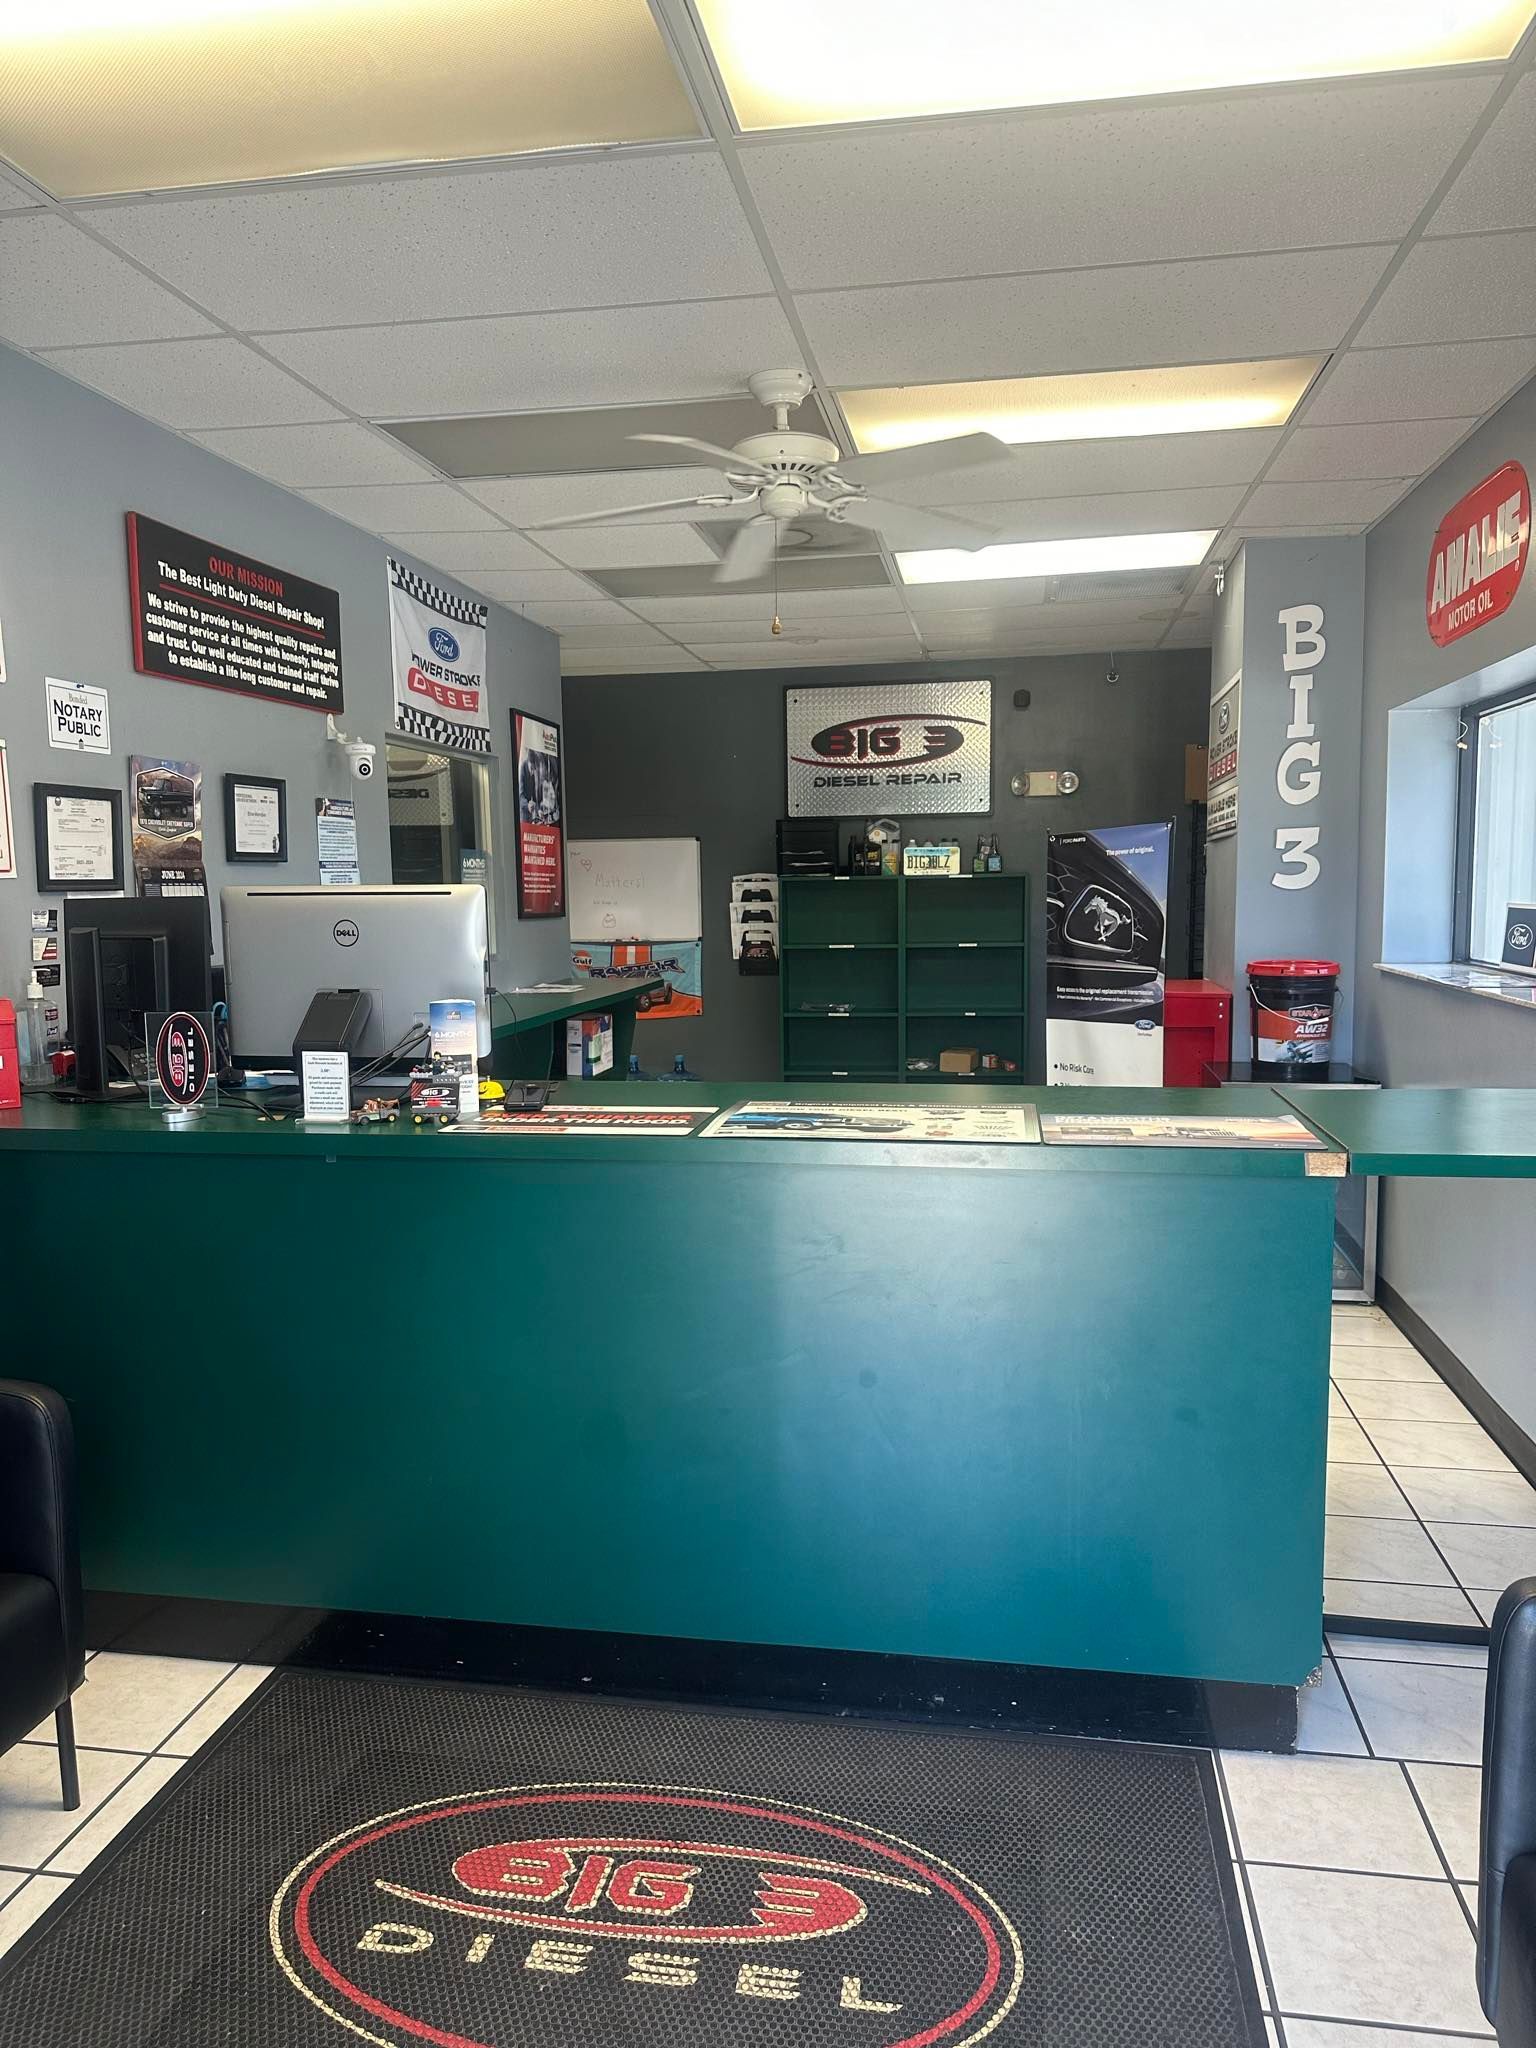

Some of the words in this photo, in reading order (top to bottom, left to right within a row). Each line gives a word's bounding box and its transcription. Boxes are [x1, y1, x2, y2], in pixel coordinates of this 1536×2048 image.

[1431, 490, 1521, 614] AMALIE
[158, 561, 177, 580] The
[180, 569, 201, 588] Best
[204, 577, 226, 597] Light
[229, 587, 248, 606] Duty
[250, 593, 275, 612] Diesel
[277, 602, 301, 620] Repair
[304, 611, 324, 629] Shop!
[209, 557, 234, 580] OUR
[238, 569, 283, 597] MISSION
[148, 593, 161, 608] We
[164, 599, 188, 616] strive
[190, 606, 198, 619] to
[201, 611, 230, 628] provide
[232, 619, 244, 633] the
[246, 624, 273, 642] highest
[275, 634, 298, 651] quality
[300, 642, 322, 656] repairs
[324, 649, 335, 659] and
[1448, 599, 1476, 630] MOTOR
[1478, 588, 1493, 613] OIL
[146, 613, 187, 632] customer
[189, 624, 219, 641] service
[221, 634, 229, 644] at
[231, 637, 240, 647] all
[243, 640, 263, 653] times
[265, 645, 280, 658] with
[282, 652, 310, 667] honesty,
[311, 659, 338, 676] integrity
[148, 631, 164, 644] and
[166, 636, 190, 651] trust.
[192, 641, 206, 654] Our
[209, 646, 225, 660] well
[227, 651, 261, 668] educated
[263, 660, 276, 672] and
[278, 664, 301, 680] trained
[304, 673, 319, 685] staff
[321, 676, 339, 688] thrive
[434, 633, 453, 656] Ford
[169, 651, 178, 664] to
[180, 657, 217, 673] establish
[219, 666, 224, 675] a
[226, 665, 238, 678] life
[240, 670, 256, 685] long
[258, 675, 290, 691] customer
[293, 681, 305, 693] and
[306, 687, 327, 699] repair.
[54, 699, 103, 721] NOTARY
[1277, 604, 1326, 806] BIG
[58, 716, 102, 738] PUBLIC
[811, 727, 901, 762] BIG
[923, 726, 964, 757] 3
[814, 774, 880, 788] DIESEL
[886, 772, 962, 786] REPAIR
[1272, 826, 1321, 890] 3
[1512, 926, 1529, 946] Ford
[572, 956, 592, 965] Gulf
[1294, 1024, 1328, 1034] AW32
[1060, 1063, 1068, 1072] No
[1069, 1064, 1082, 1072] Risk
[1083, 1065, 1094, 1074] Core
[451, 1841, 702, 1916] BIG
[752, 1871, 867, 1932] 3
[356, 1920, 903, 2014] DIESEL
